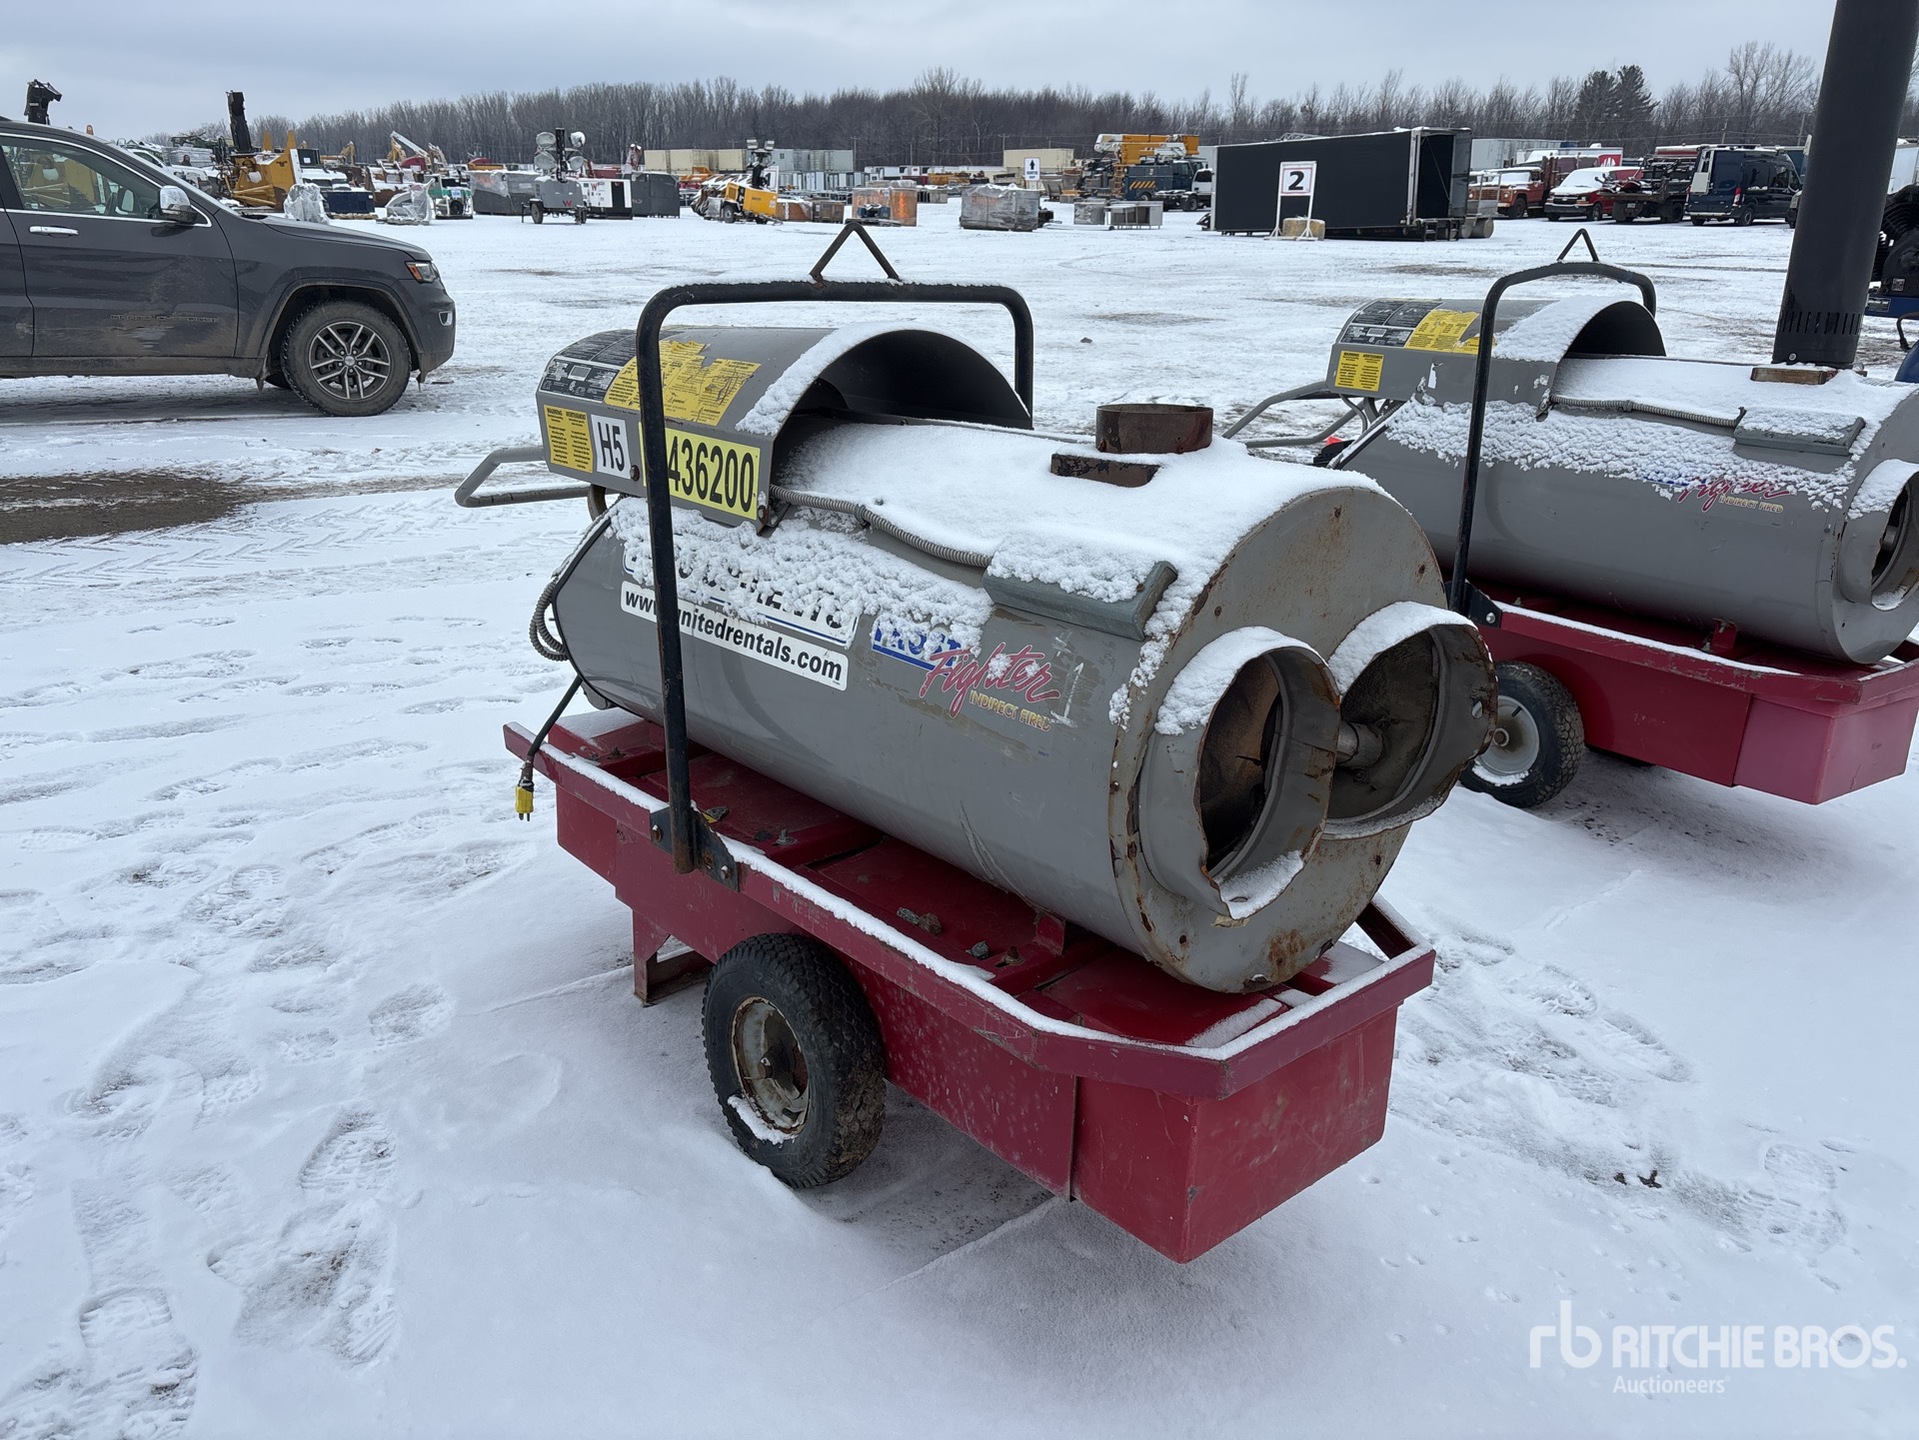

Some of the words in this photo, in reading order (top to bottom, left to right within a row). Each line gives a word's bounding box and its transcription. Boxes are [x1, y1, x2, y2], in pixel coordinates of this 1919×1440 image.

[1288, 170, 1305, 191] 2
[597, 421, 626, 472] H5
[625, 590, 843, 682] wwnitedrentals.com
[969, 689, 1019, 720] INDIRECT
[1019, 707, 1052, 733] FIRED
